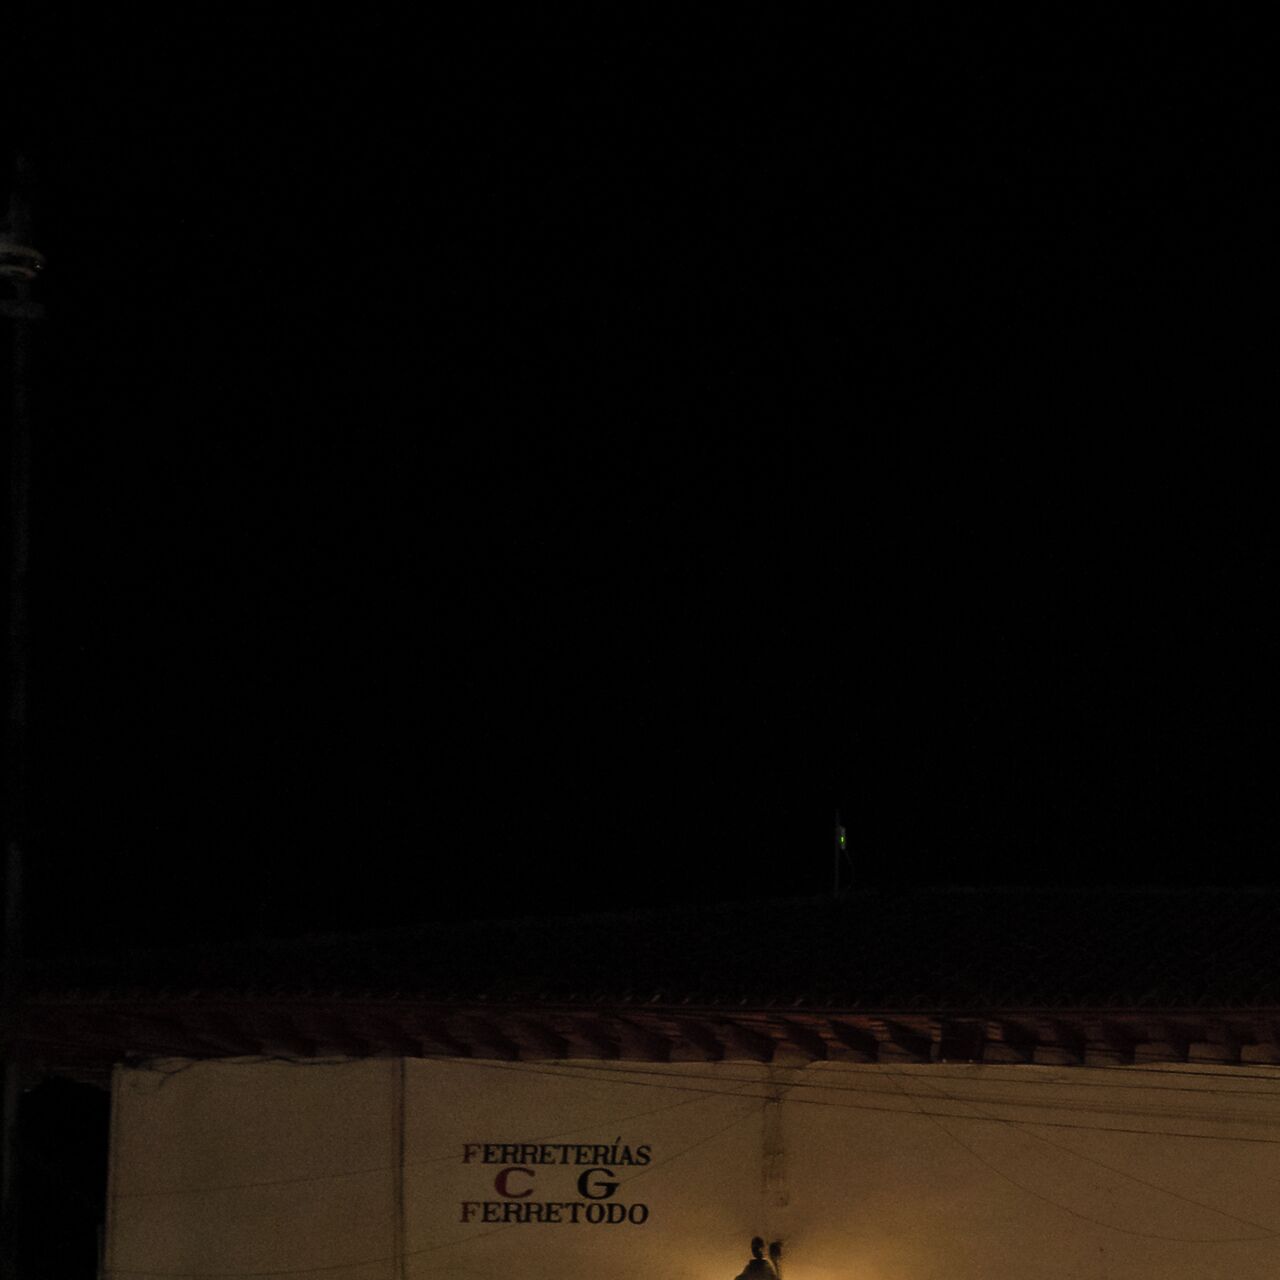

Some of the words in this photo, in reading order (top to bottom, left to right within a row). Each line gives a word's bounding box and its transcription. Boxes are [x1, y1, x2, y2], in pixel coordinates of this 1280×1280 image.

[462, 1136, 651, 1165] FERRETERÍAS
[494, 1167, 535, 1198] C
[577, 1168, 620, 1200] G
[459, 1202, 649, 1224] FERRETODO
